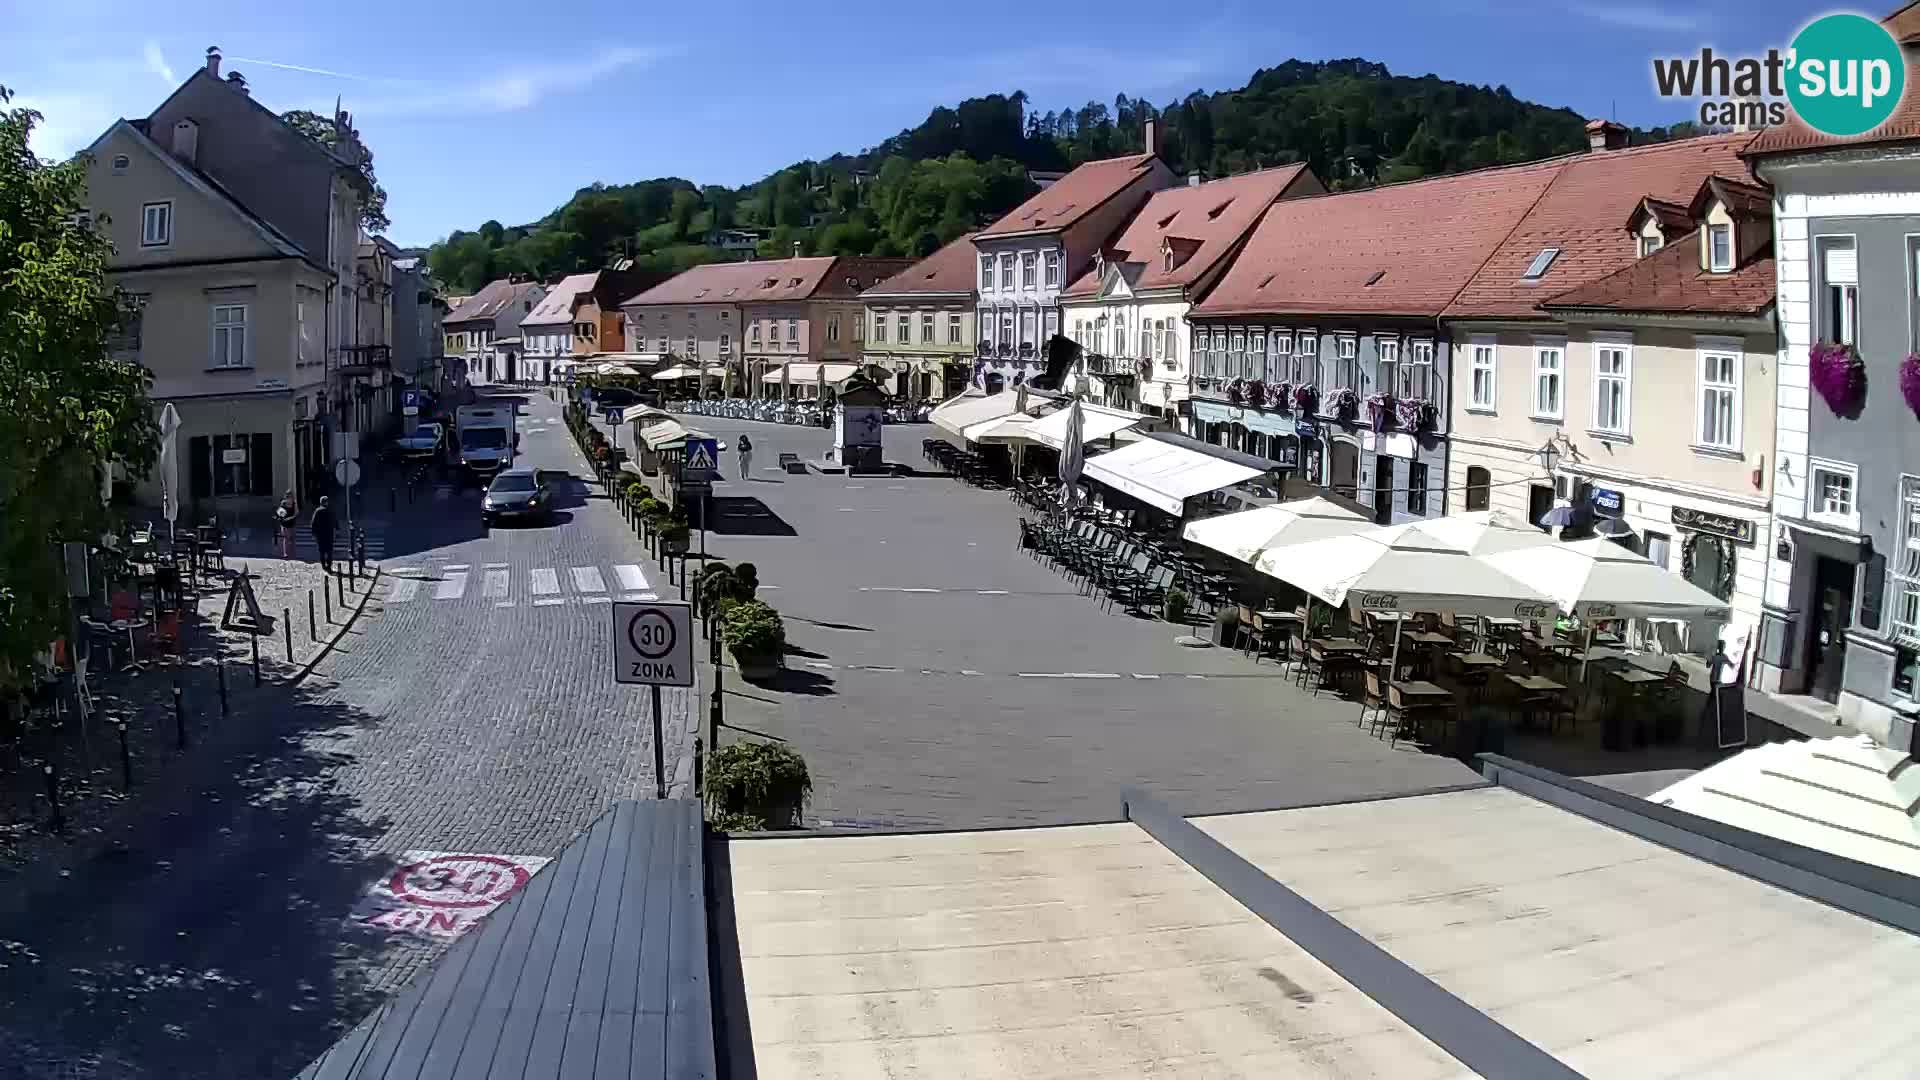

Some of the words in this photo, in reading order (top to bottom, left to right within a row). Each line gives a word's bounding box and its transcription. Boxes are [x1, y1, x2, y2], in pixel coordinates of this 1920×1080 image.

[407, 393, 414, 404] P
[641, 624, 665, 646] 30
[631, 662, 676, 679] ZONA
